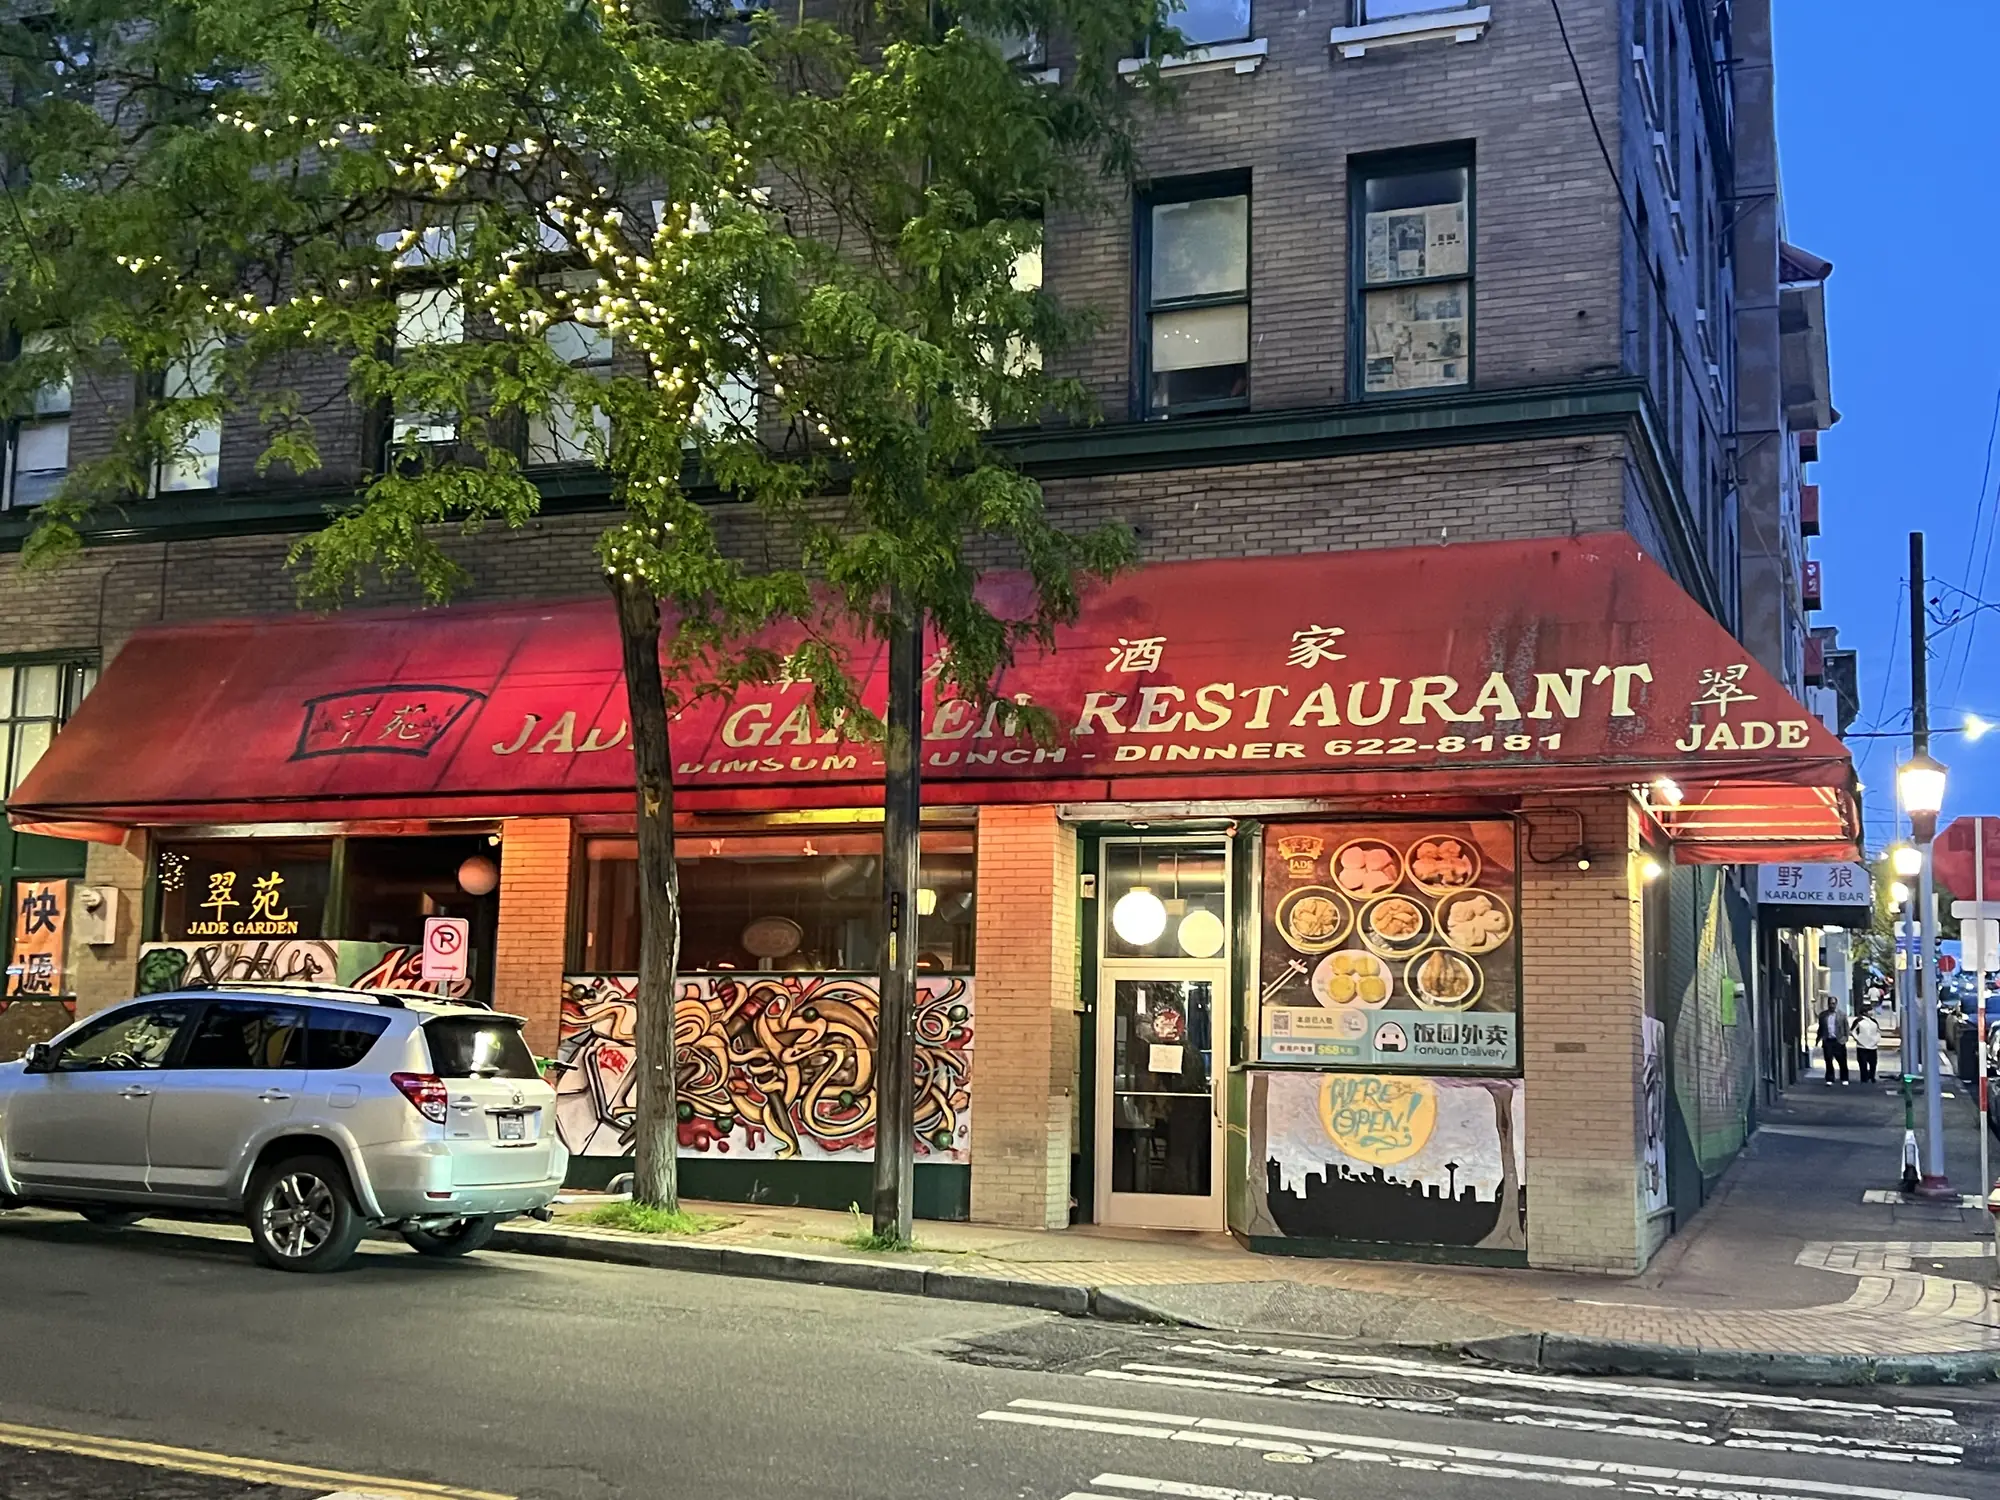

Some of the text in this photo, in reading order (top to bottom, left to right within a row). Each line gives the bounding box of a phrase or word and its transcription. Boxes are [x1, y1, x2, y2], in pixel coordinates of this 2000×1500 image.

[1691, 663, 1759, 717] 翠
[491, 663, 1654, 755] JAD GAEN RESTAURANT
[920, 747, 1067, 767] UNCH
[1114, 742, 1307, 762] DINNER
[1324, 733, 1562, 756] 622-8181
[1675, 720, 1810, 752] JADE
[1289, 859, 1315, 873] JADE
[1777, 865, 1853, 889] 野狼
[199, 871, 289, 922] 翠苑
[1765, 890, 1824, 901] KARAOKE
[1838, 892, 1865, 902] BAR
[187, 920, 299, 936] JADE GARDEN
[1414, 1045, 1508, 1060] Fantuan Delivery
